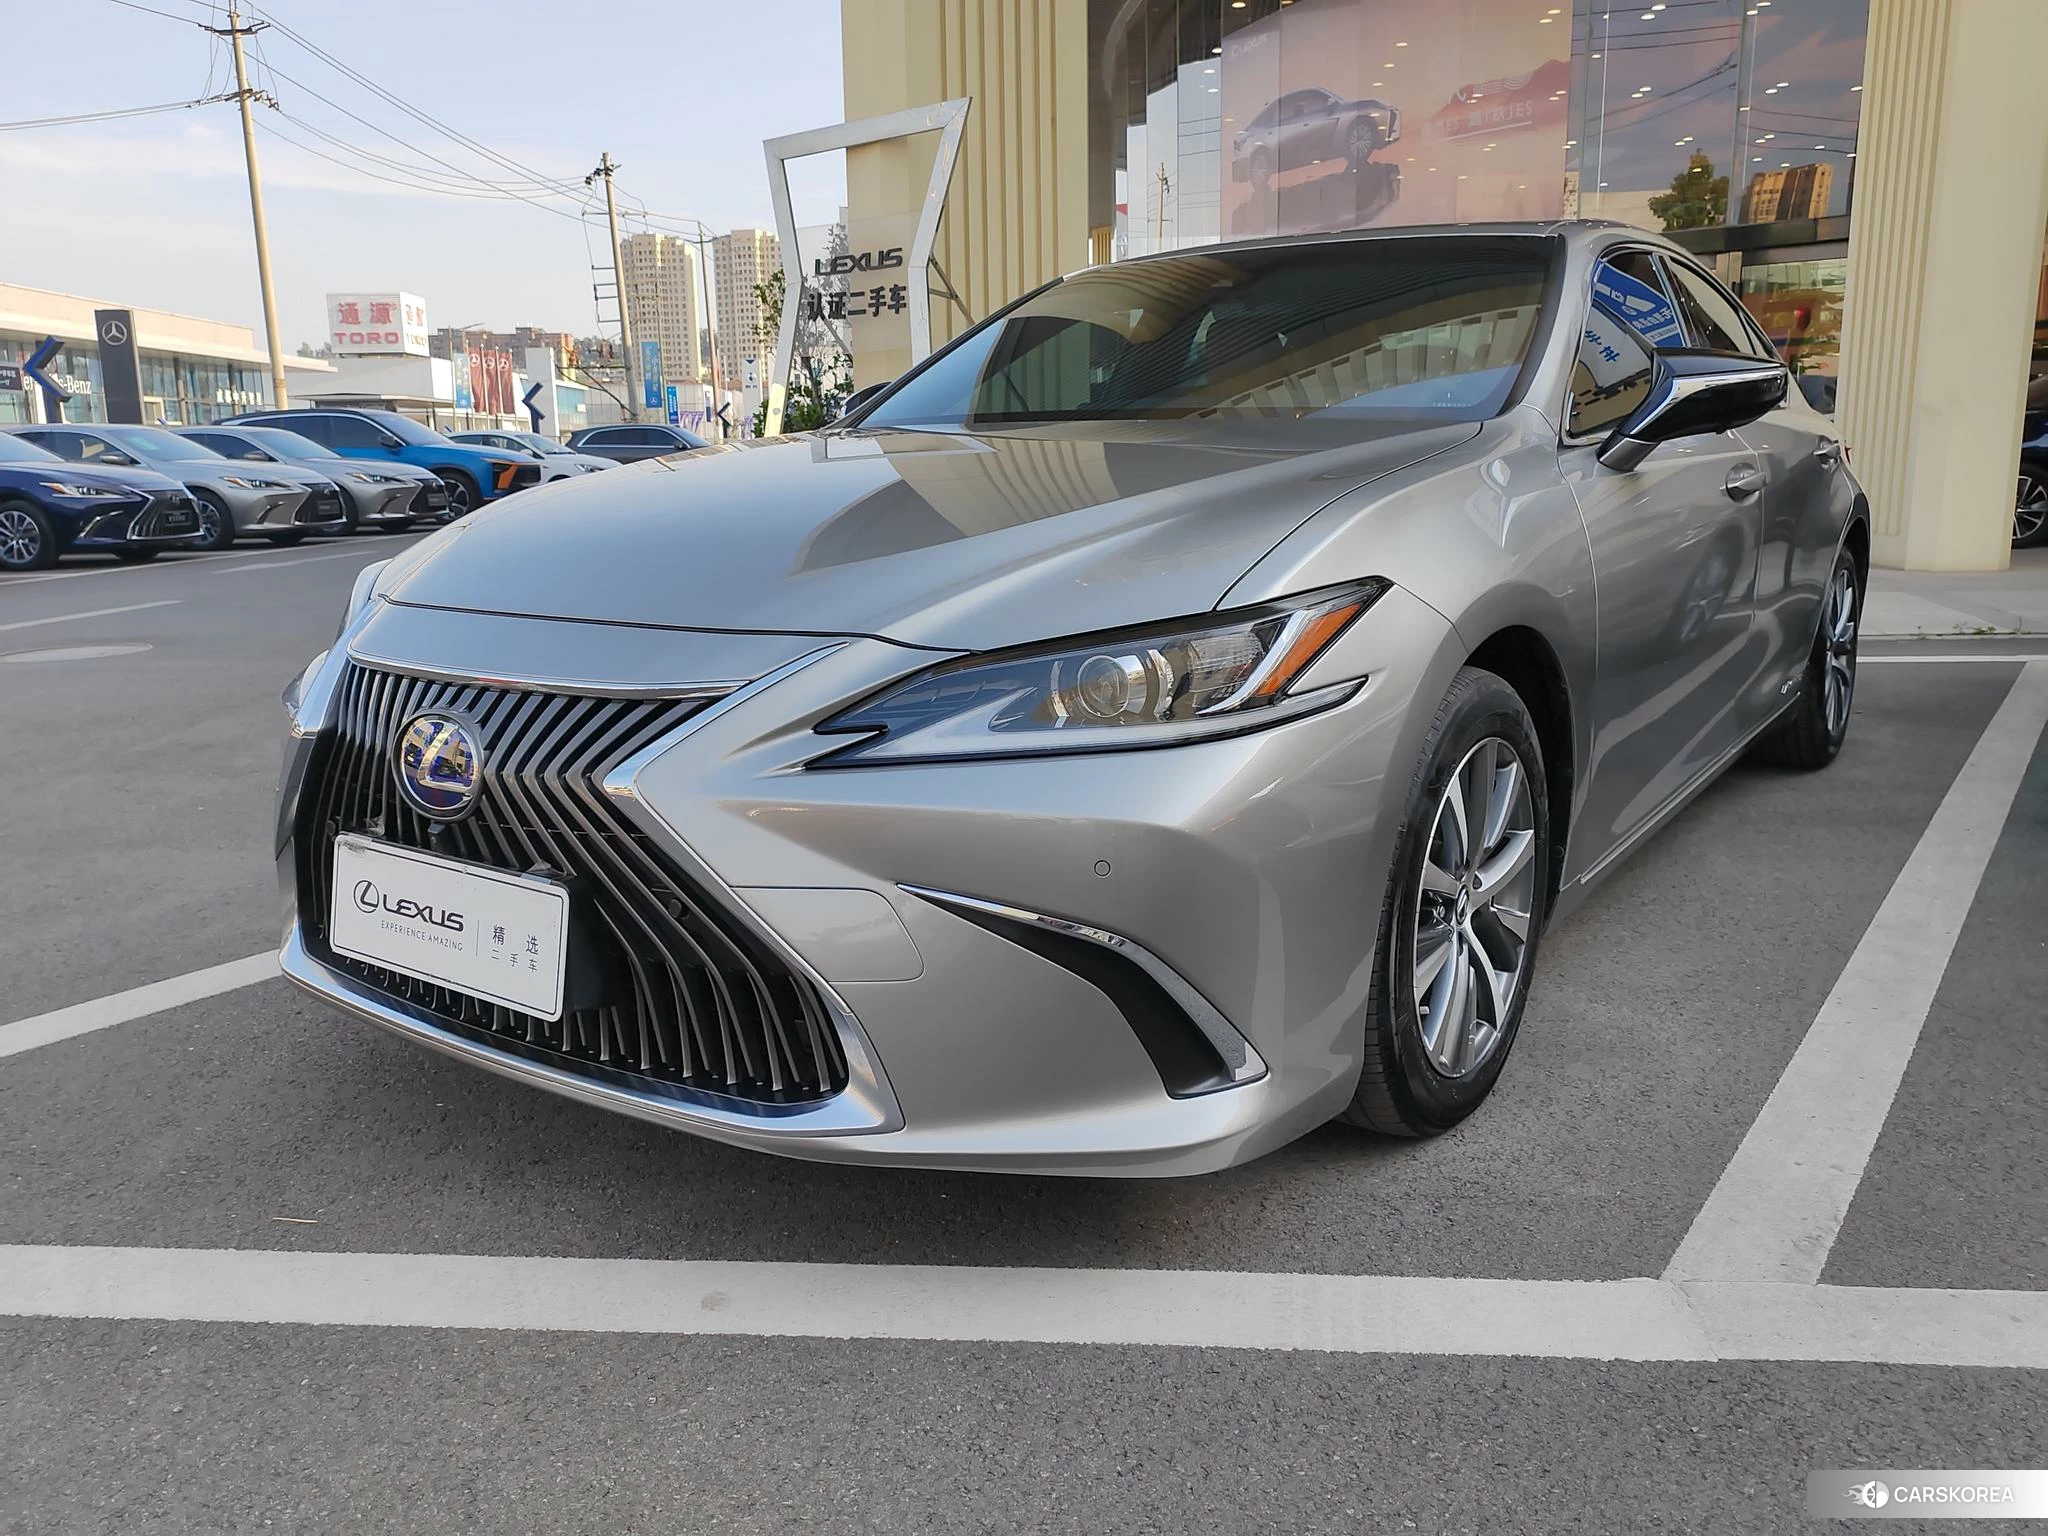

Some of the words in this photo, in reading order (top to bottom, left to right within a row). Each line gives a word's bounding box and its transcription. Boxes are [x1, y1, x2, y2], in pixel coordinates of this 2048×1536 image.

[815, 247, 903, 276] LEXUS
[807, 284, 907, 322] 认证二手车
[334, 332, 399, 345] TORO
[383, 893, 464, 932] LEXUS
[381, 920, 426, 941] EXPERIENCE
[427, 934, 463, 952] AMAZING
[493, 924, 539, 955] 精选
[491, 949, 538, 973] 二手车
